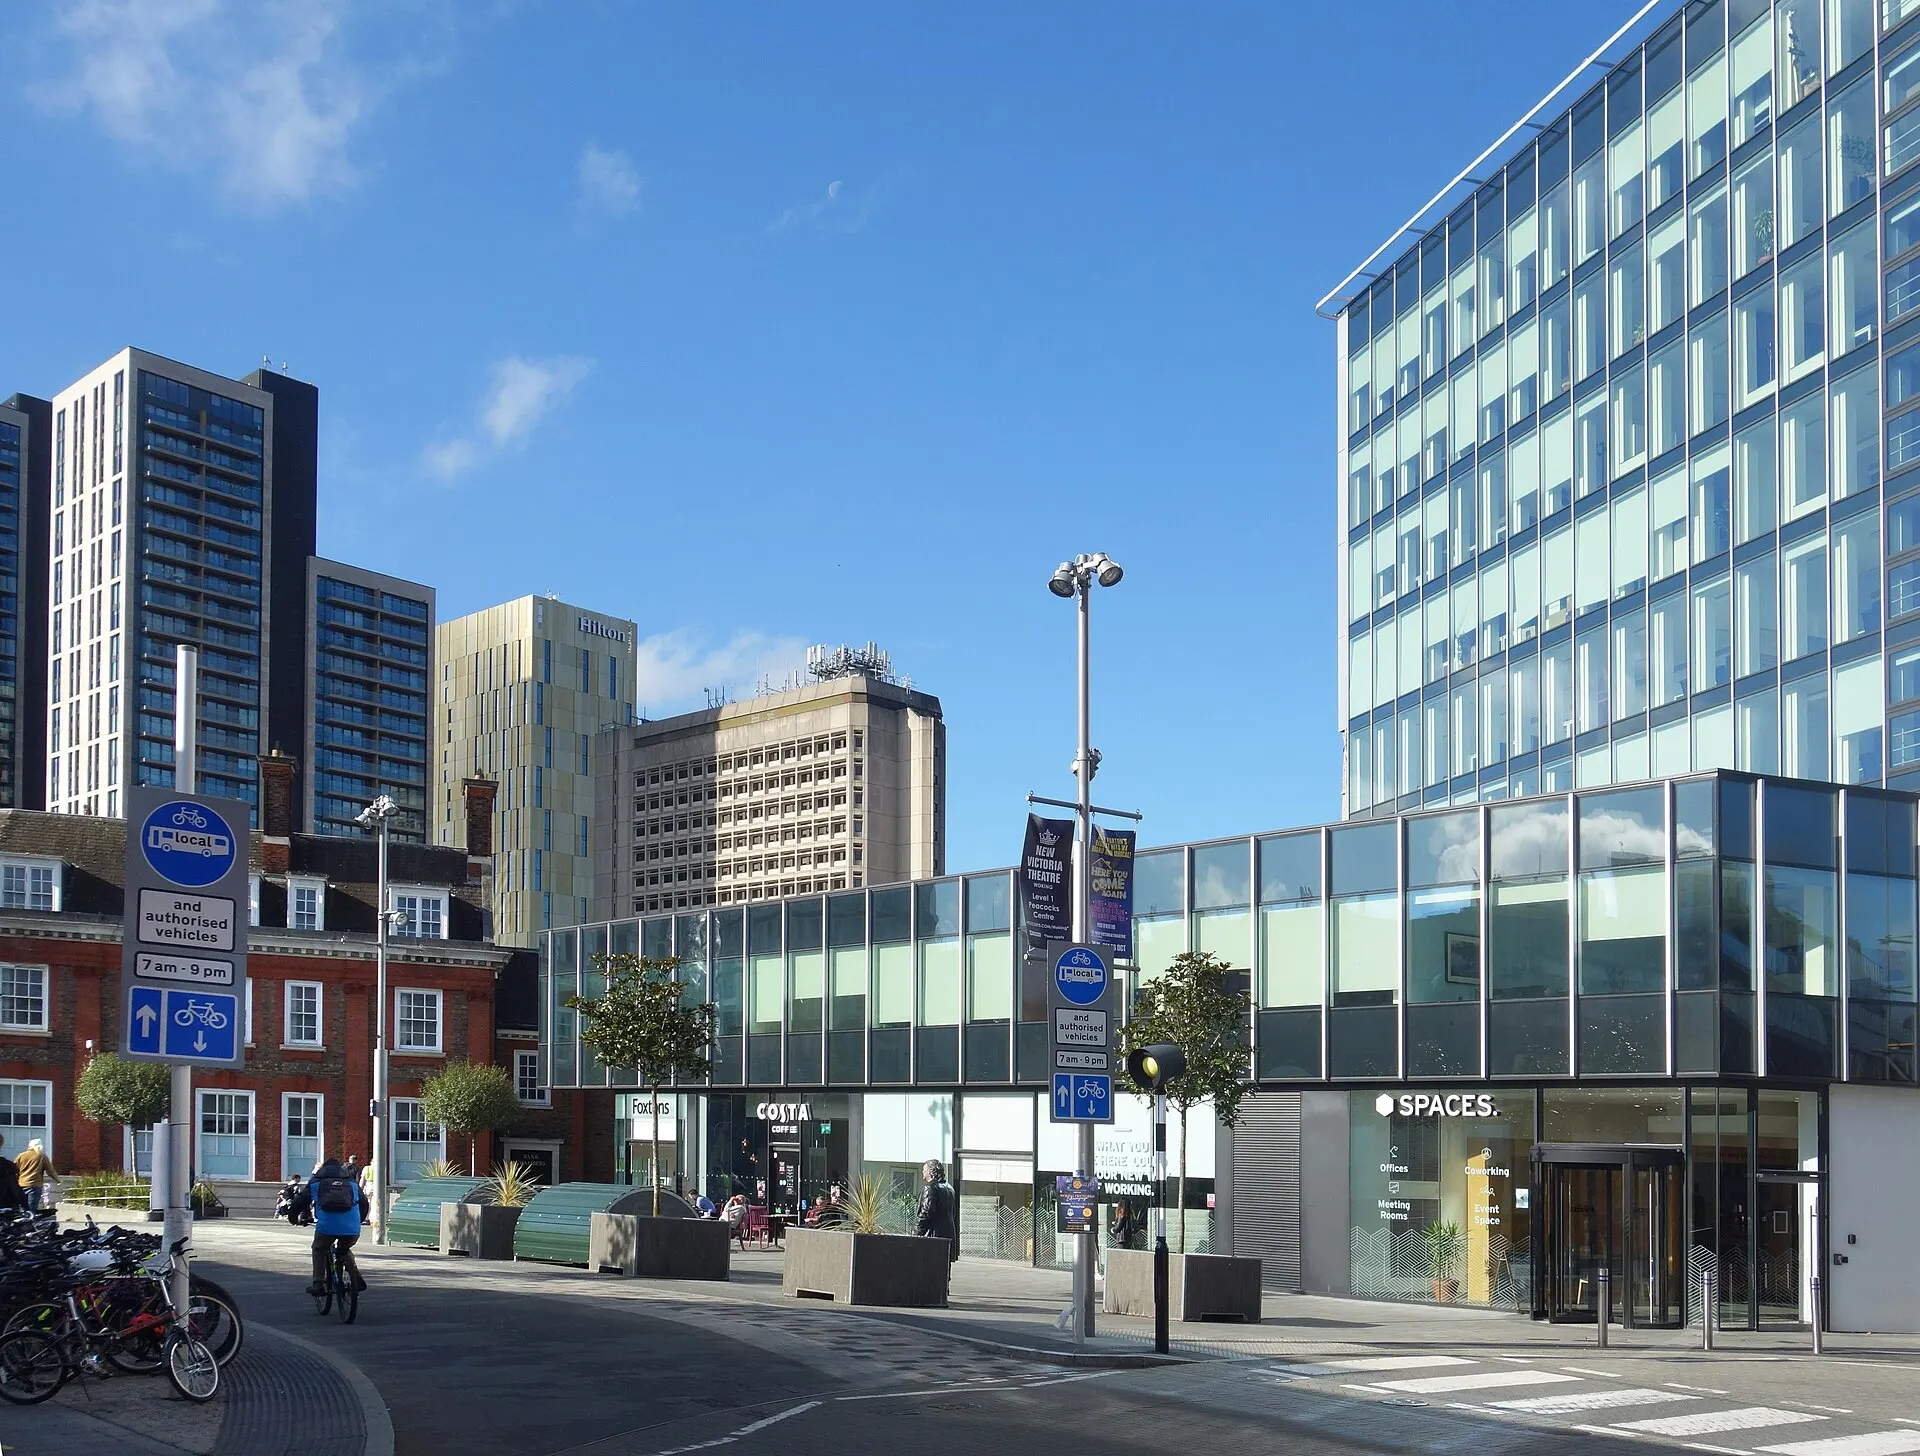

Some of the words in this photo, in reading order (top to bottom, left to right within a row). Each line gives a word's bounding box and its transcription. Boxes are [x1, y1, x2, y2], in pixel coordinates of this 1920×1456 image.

[580, 616, 626, 642] Hilton
[175, 831, 212, 848] local
[1035, 845, 1055, 858] NEW
[1027, 856, 1063, 872] VICTORIA
[1027, 868, 1061, 884] THEATRE
[1091, 866, 1111, 877] HERE
[1113, 870, 1128, 878] YOU
[1033, 882, 1053, 890] WOKING
[1032, 893, 1049, 901] Level
[1102, 890, 1127, 900] AGAIN
[173, 901, 201, 912] and
[1028, 901, 1060, 912] Peacocks
[145, 911, 228, 930] authorised
[1033, 911, 1055, 920] Centre
[155, 928, 218, 943] vehicles
[1073, 968, 1094, 978] local
[1073, 1014, 1089, 1022] and
[1059, 1023, 1104, 1032] authorised
[1064, 1032, 1098, 1042] vehicles
[633, 1098, 670, 1115] Foxtns
[1399, 1094, 1498, 1117] SPACES.
[756, 1103, 809, 1122] COSTA
[771, 1125, 798, 1134] COFFEE
[1096, 1141, 1125, 1152] WHAT
[1128, 1142, 1150, 1153] YOU
[1380, 1163, 1409, 1173] Offices
[1464, 1166, 1510, 1178] Coworking
[1121, 1171, 1143, 1182] NEW
[1104, 1182, 1155, 1197] WORKING.
[1378, 1200, 1411, 1211] Meeting
[1474, 1205, 1500, 1214] Event
[1380, 1211, 1408, 1221] Rooms
[1474, 1215, 1500, 1225] Space
